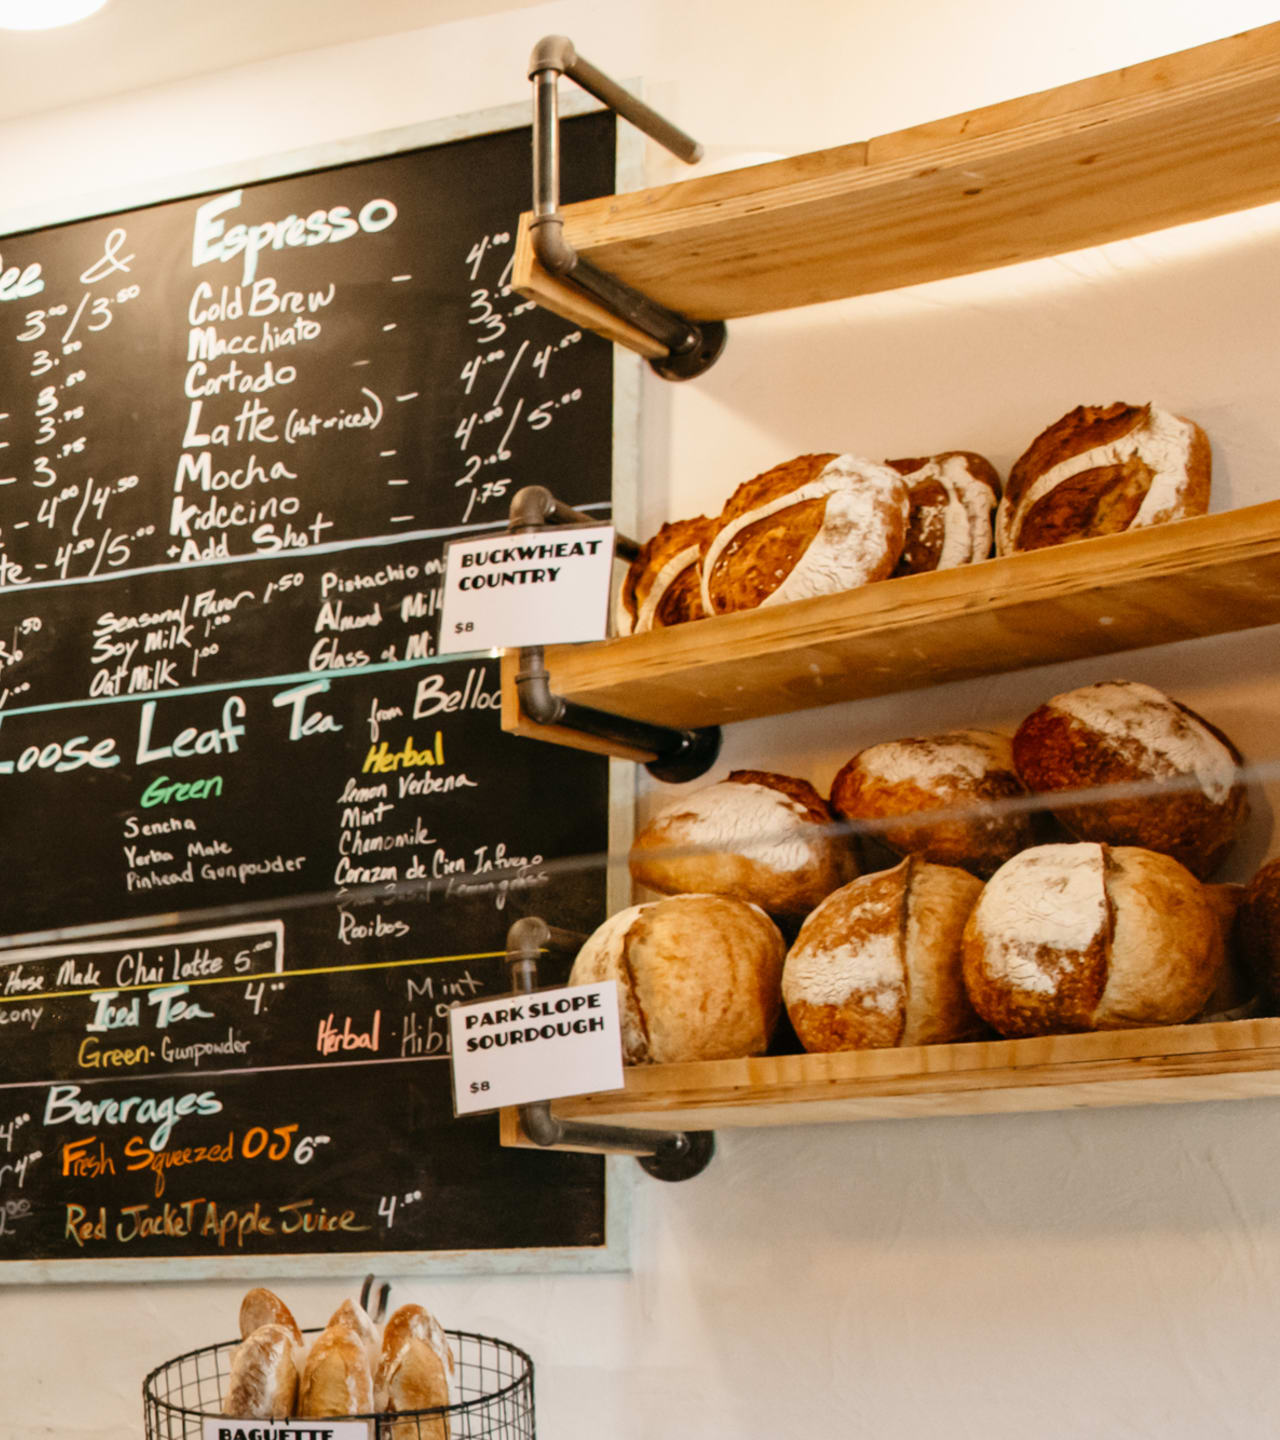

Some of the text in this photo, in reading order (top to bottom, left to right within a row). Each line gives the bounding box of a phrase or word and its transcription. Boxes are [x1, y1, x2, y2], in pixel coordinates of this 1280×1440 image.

[80, 229, 135, 284] &
[193, 190, 397, 287] Espresso
[188, 281, 243, 326] Cold
[188, 315, 321, 361] Macchiato
[182, 397, 279, 449] Latte
[173, 450, 297, 493] Mocha
[250, 513, 334, 555] Shot
[461, 540, 602, 568] BUCKWHEAT
[320, 564, 420, 598] Pistachio
[458, 567, 560, 591] COUNTRY
[455, 622, 474, 634] $8
[136, 701, 246, 765] Leaf
[272, 678, 343, 741] Tea
[362, 730, 445, 774] Herbal
[141, 775, 223, 808] Green
[398, 772, 478, 800] Verbena
[124, 816, 197, 838] Sencha
[340, 803, 394, 829] Mint
[339, 817, 437, 856] Chamomile
[126, 856, 306, 892] Pinhead Gunpowder
[4, 952, 164, 994] House Made Chai
[407, 970, 484, 1001] Mint
[86, 985, 215, 1032] Iced Tea
[464, 1005, 524, 1030] PARK
[528, 993, 602, 1020] SLOPE
[317, 1009, 380, 1055] Herbal
[465, 1016, 605, 1053] SOURDOUGH
[78, 1037, 148, 1068] Green
[469, 1080, 490, 1094] $8
[43, 1086, 223, 1151] Beverages
[62, 1124, 299, 1198] Fresh Squeezed OJ
[66, 1204, 105, 1247] Red
[202, 1202, 280, 1247] Apple
[278, 1199, 371, 1233] Juice
